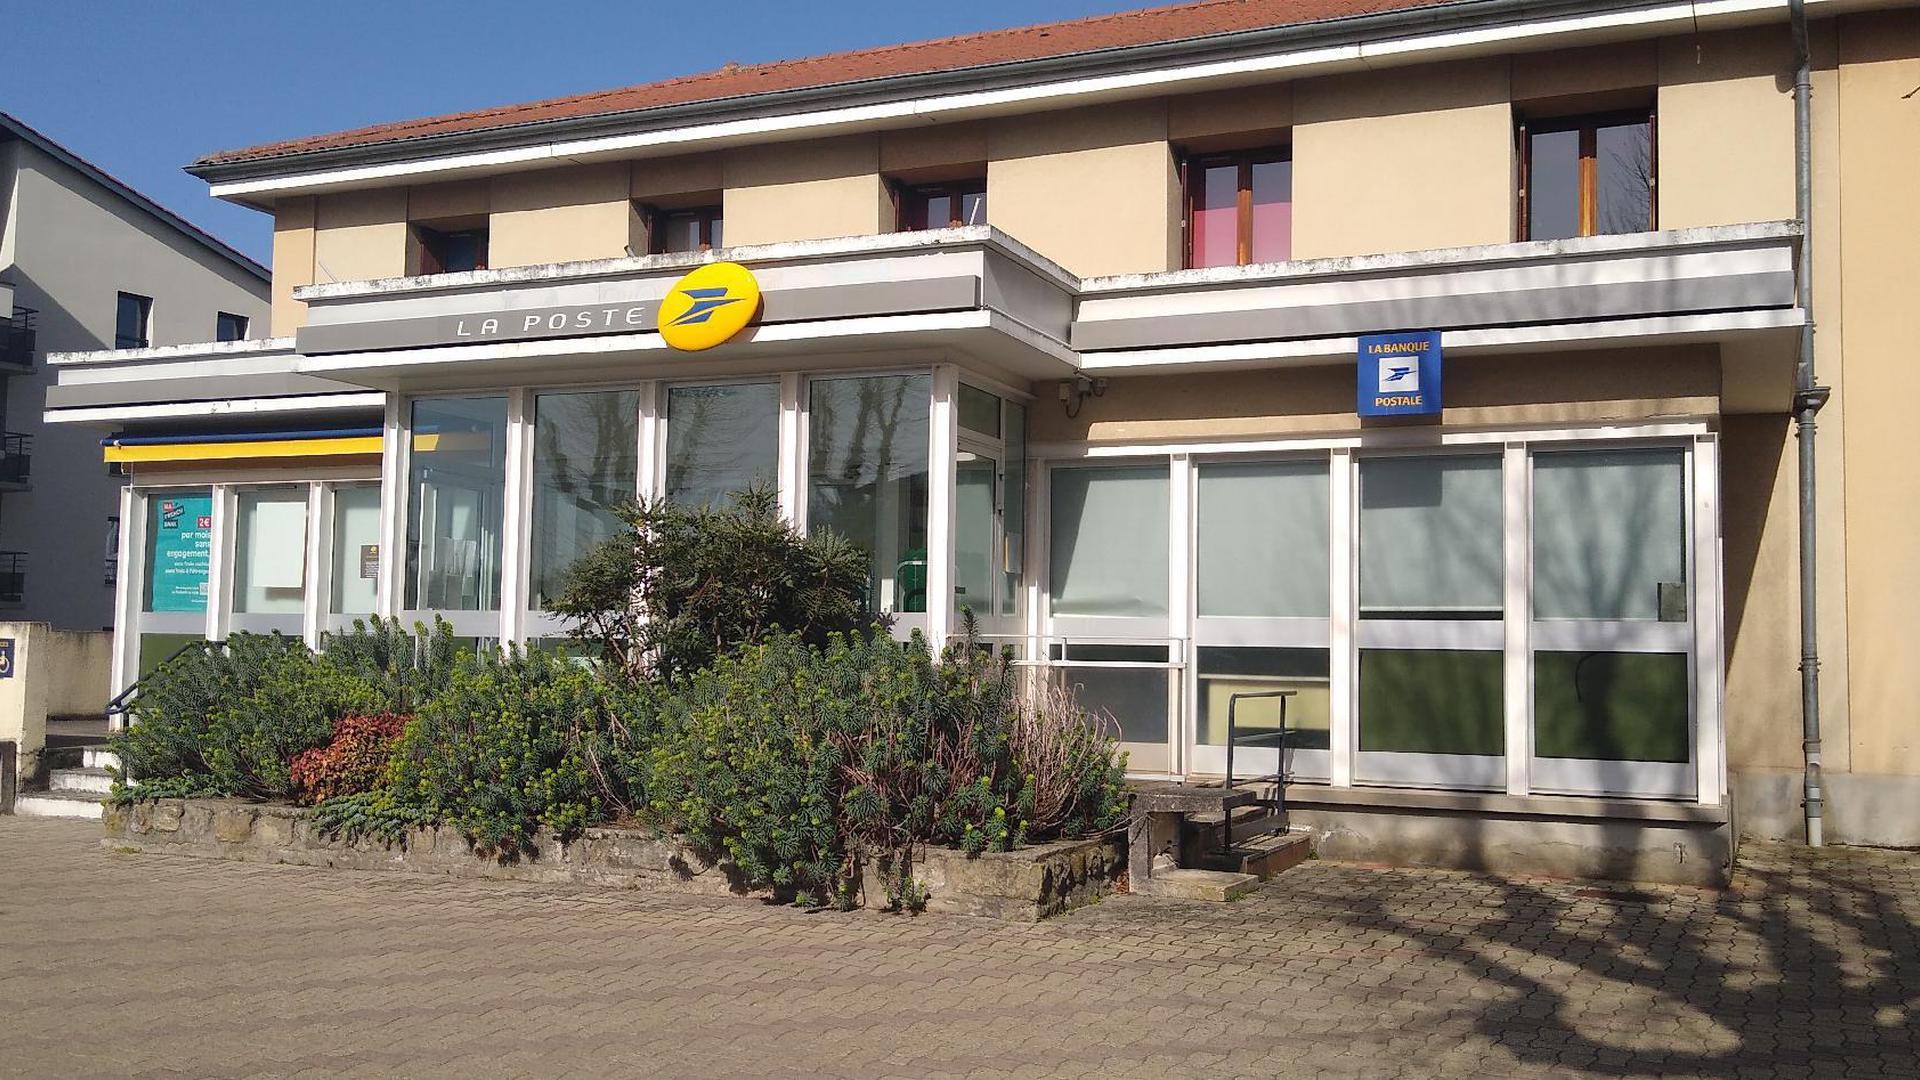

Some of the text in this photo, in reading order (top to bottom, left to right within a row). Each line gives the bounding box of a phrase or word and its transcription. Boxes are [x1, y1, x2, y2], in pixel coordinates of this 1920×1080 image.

[457, 307, 645, 337] LA POSTE
[1368, 341, 1430, 354] LA BANQUE
[1375, 395, 1423, 407] POSTALE
[199, 517, 211, 528] 2€
[181, 532, 193, 541] par
